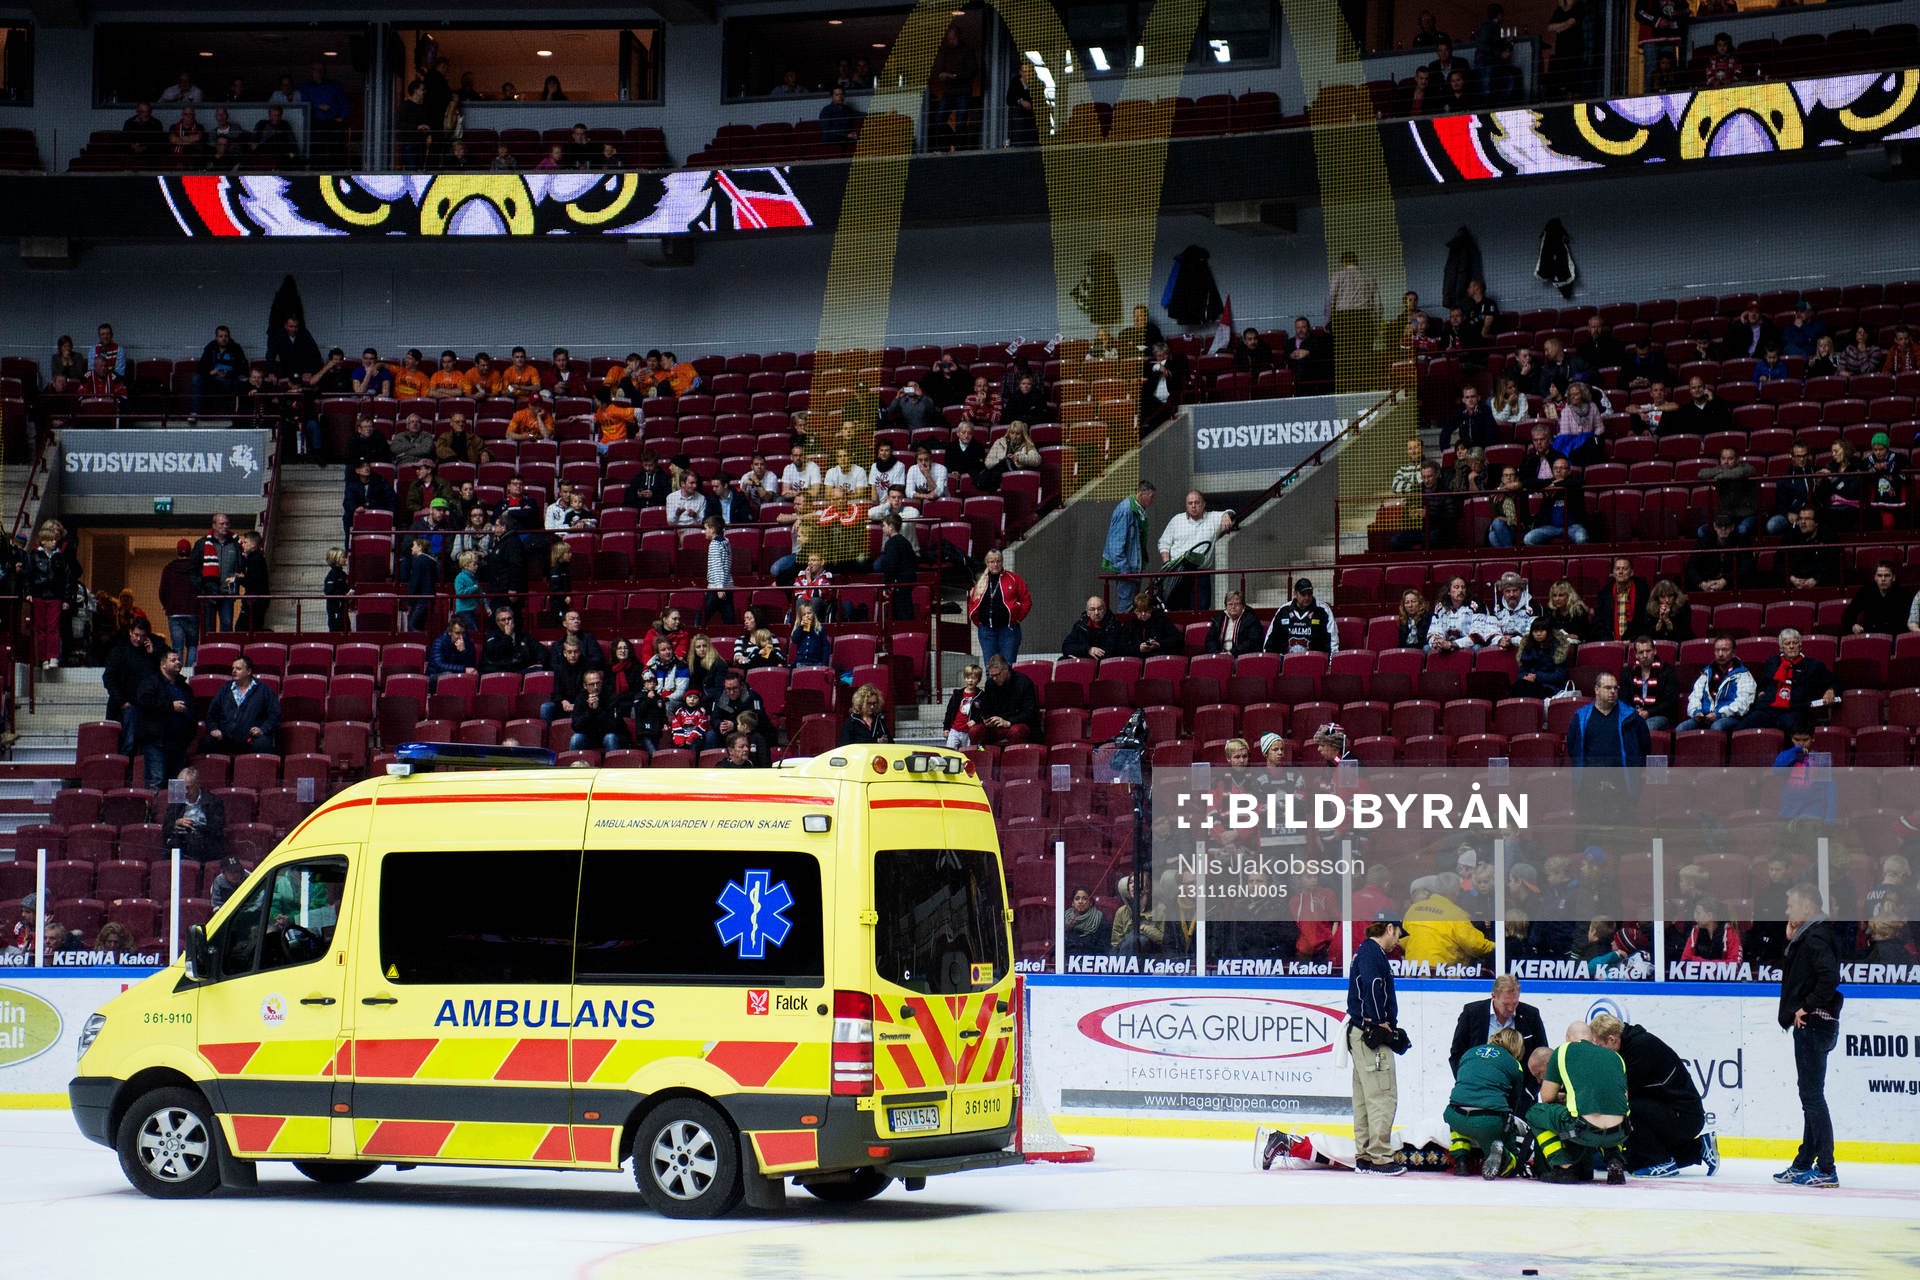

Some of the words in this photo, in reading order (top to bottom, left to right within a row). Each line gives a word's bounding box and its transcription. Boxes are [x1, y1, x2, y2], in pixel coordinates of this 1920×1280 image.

[1197, 418, 1349, 450] SYDSVENSKAN
[65, 452, 223, 473] SYDSVENSKAN
[717, 819, 755, 829] REGION
[53, 951, 115, 966] KERMA
[119, 952, 160, 966] Kakel
[1014, 959, 1046, 972] akel
[1068, 955, 1140, 973] KERMA
[1144, 959, 1190, 974] Kakel
[1217, 959, 1285, 976] KERMA
[1288, 961, 1333, 976] Kakel
[1388, 959, 1431, 976] RMA
[1435, 962, 1481, 977] Kakel
[1510, 960, 1590, 979] KERMA
[1595, 963, 1648, 980] Kakel
[1669, 961, 1753, 981] KERMA
[1839, 963, 1920, 984] KERMA
[776, 995, 808, 1010] Falck
[143, 1013, 150, 1024] 3
[152, 1013, 192, 1024] 61-9110
[434, 999, 655, 1028] AMBULANS
[1118, 1014, 1197, 1040] HAGA
[1202, 1014, 1327, 1042] GRUPPEN
[1846, 1035, 1909, 1057] RADIO
[1131, 1067, 1313, 1083] FASTIGHETSFÖRVALTNING
[1868, 1079, 1920, 1095] www.g
[965, 1101, 970, 1115] 3
[973, 1100, 981, 1114] 61
[983, 1099, 1001, 1113] 9110
[1144, 1093, 1300, 1111] www.hagagruppen.com
[895, 1109, 914, 1126] HSX
[919, 1108, 938, 1124] 543
